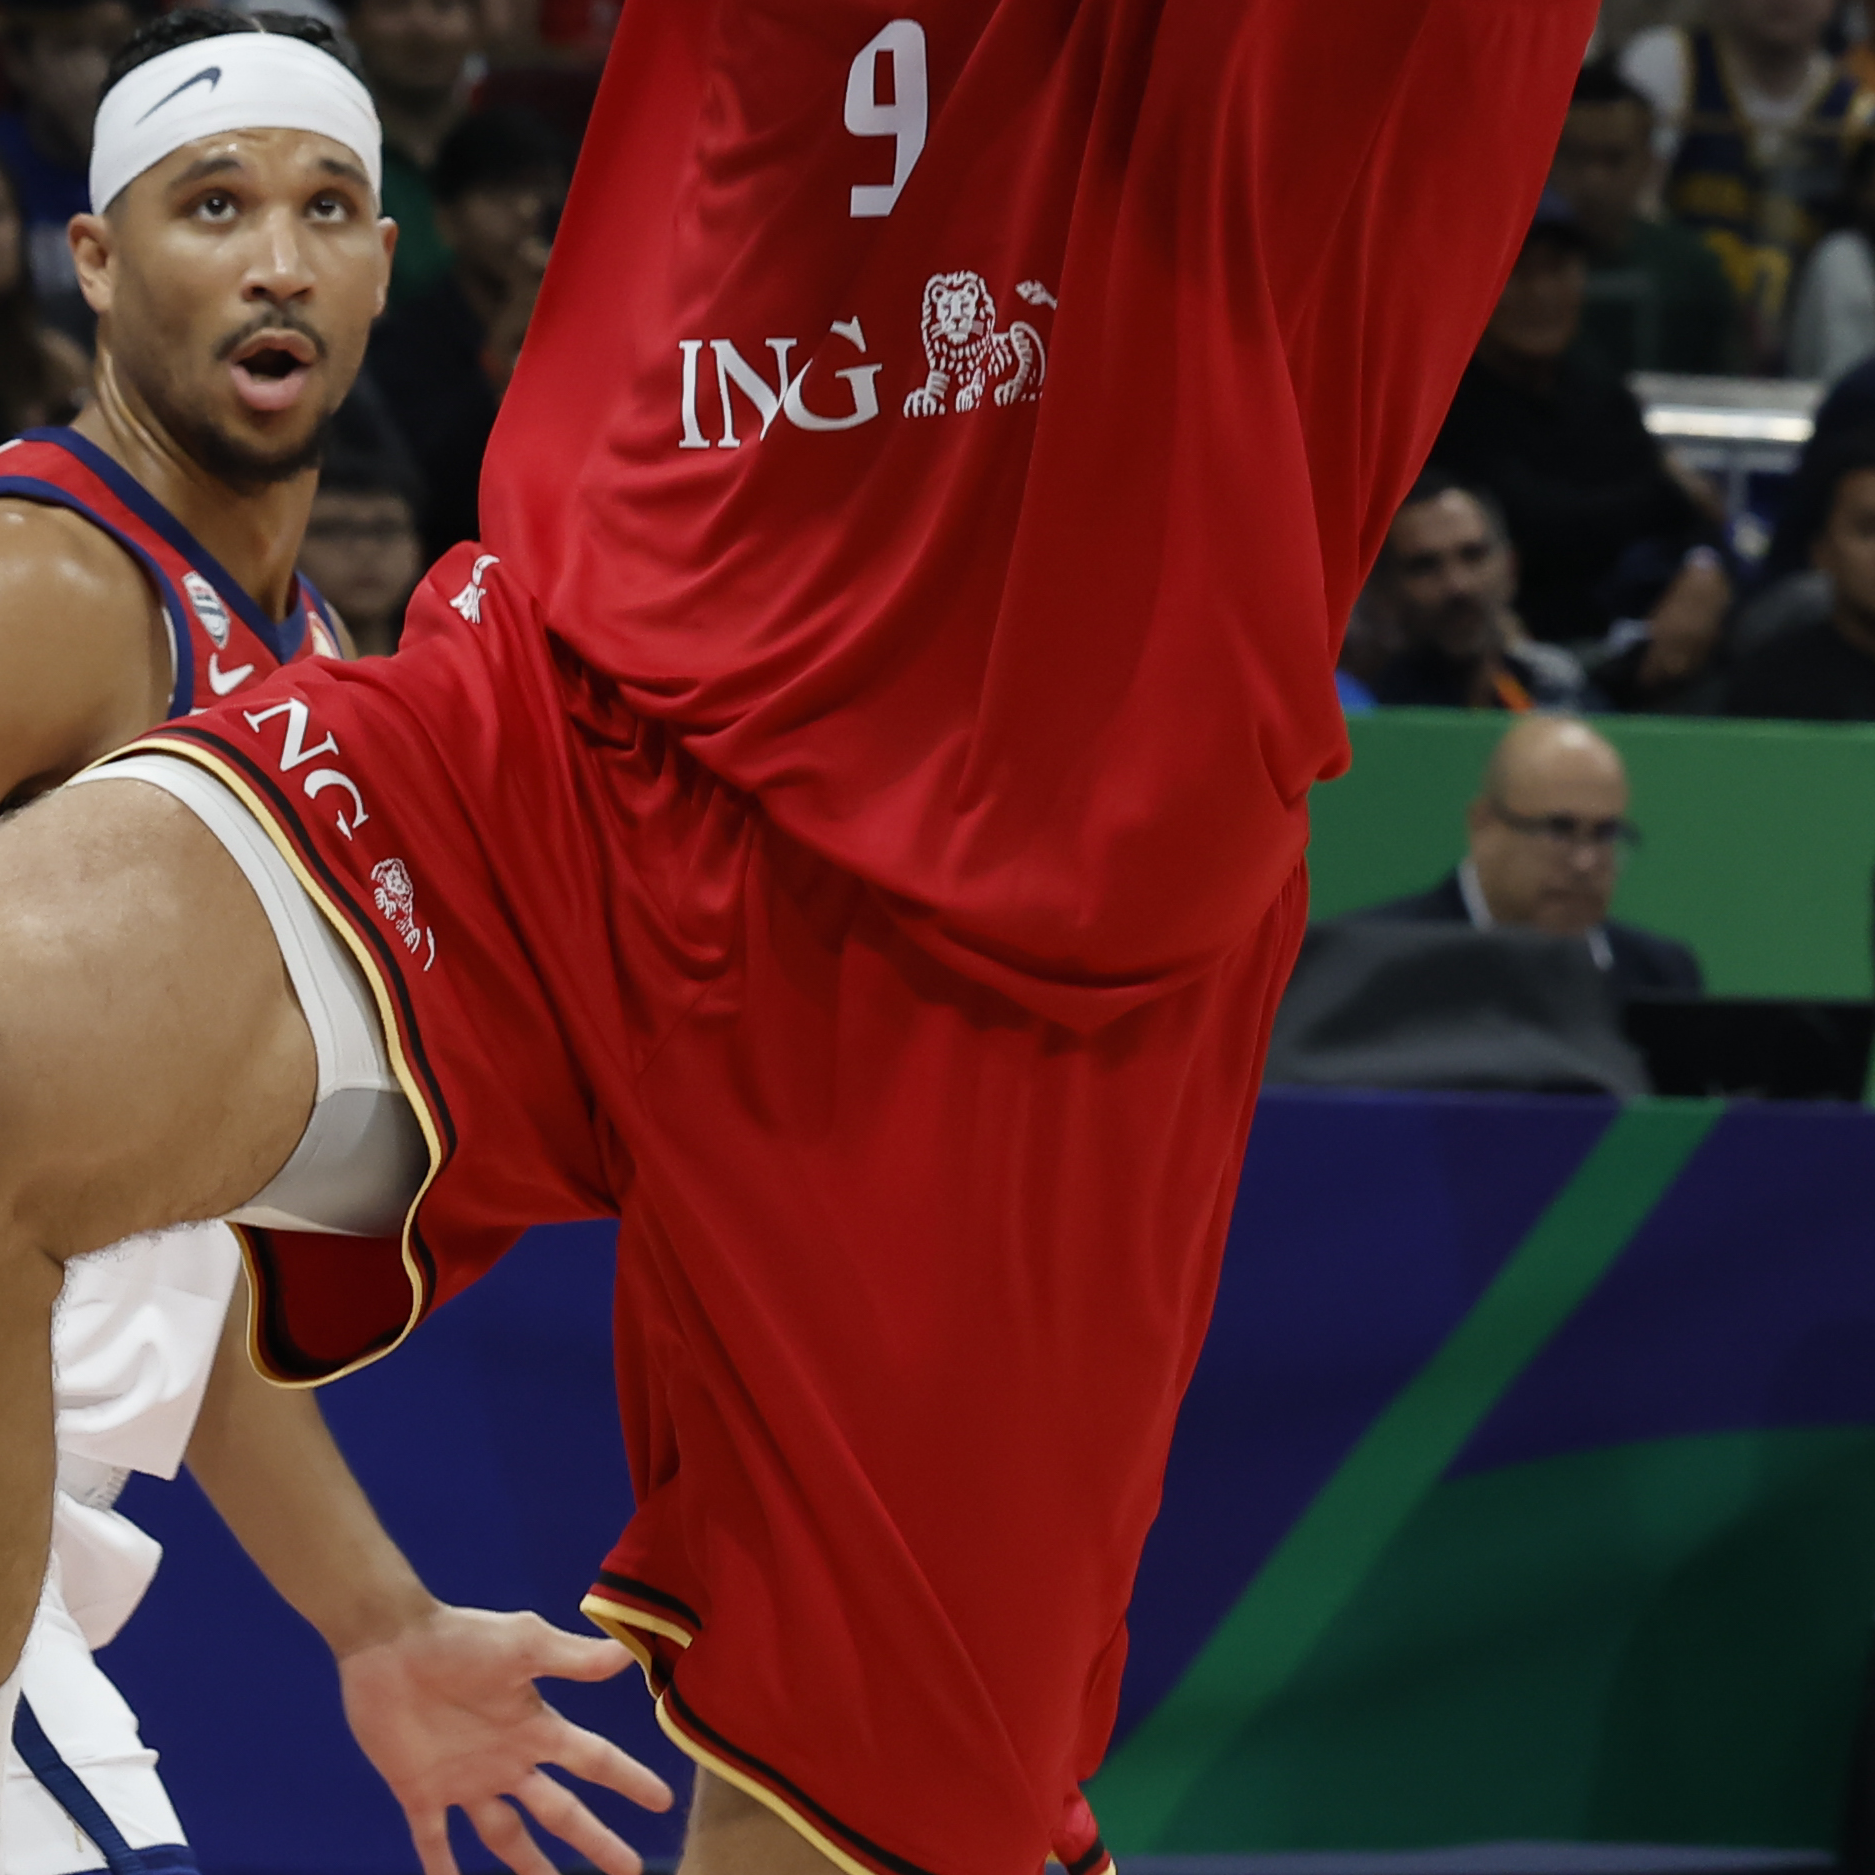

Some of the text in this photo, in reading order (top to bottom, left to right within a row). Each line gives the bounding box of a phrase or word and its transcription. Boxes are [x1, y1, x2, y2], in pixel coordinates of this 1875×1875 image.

[843, 18, 929, 218] 9
[678, 315, 883, 449] ING
[242, 696, 370, 842] NG
